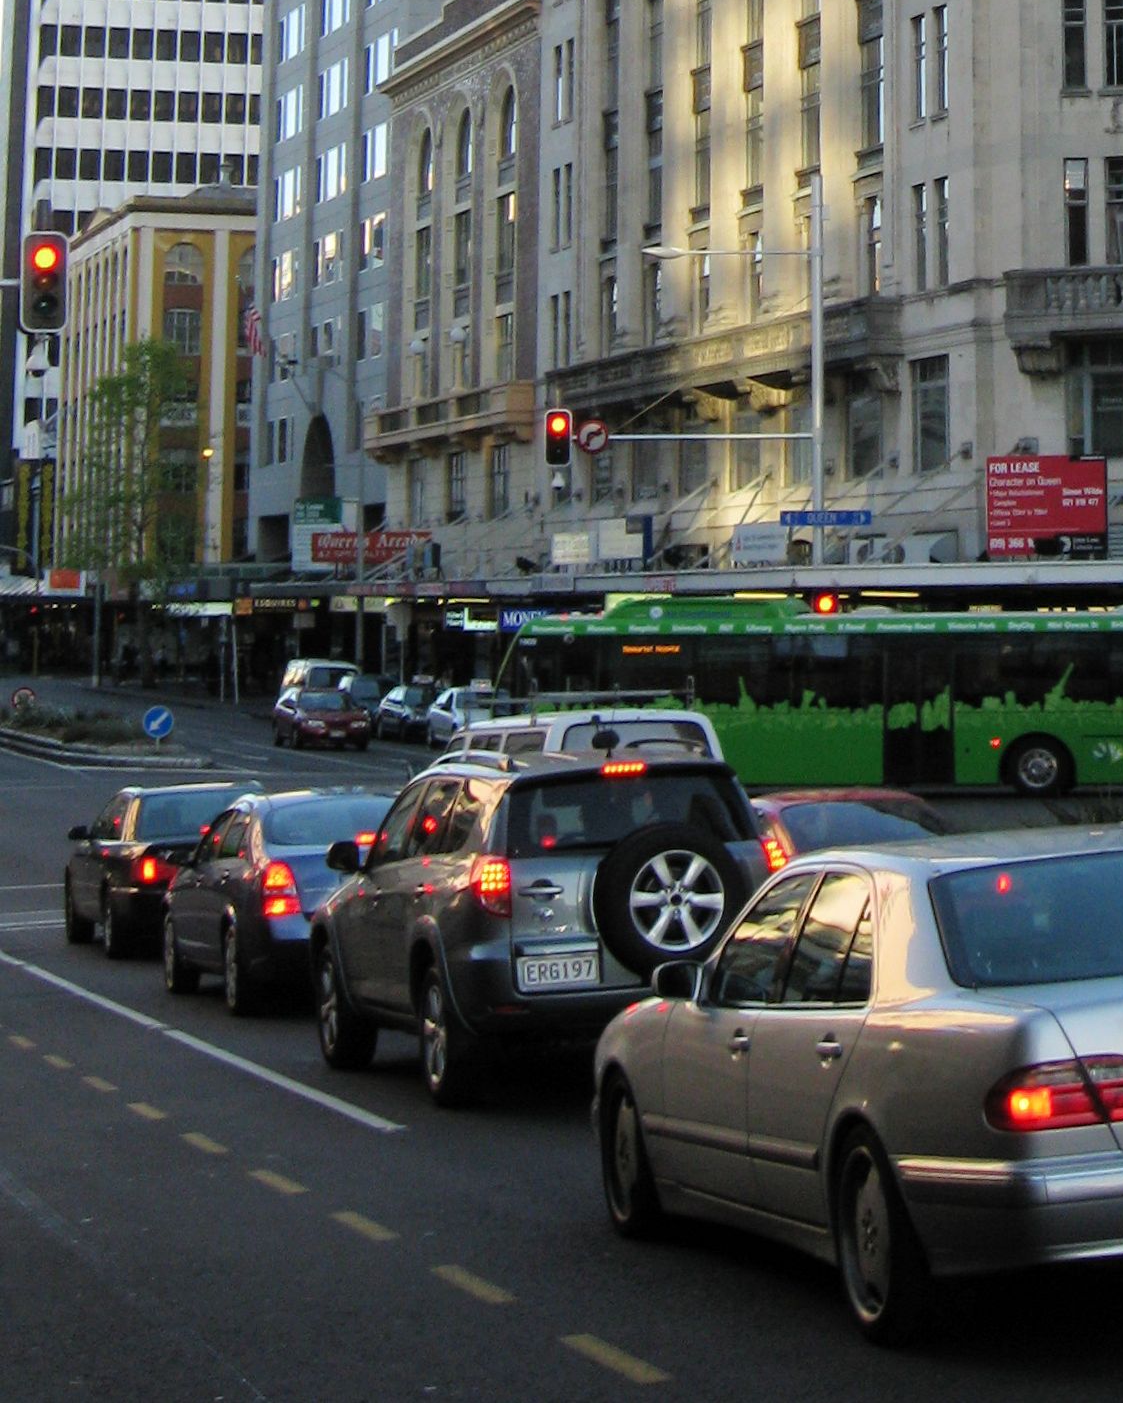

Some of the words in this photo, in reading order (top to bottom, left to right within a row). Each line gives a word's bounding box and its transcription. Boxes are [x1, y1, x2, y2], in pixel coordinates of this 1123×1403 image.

[989, 463, 1008, 474] FOR
[1010, 462, 1040, 473] LEASE
[526, 959, 594, 984] ERG197
